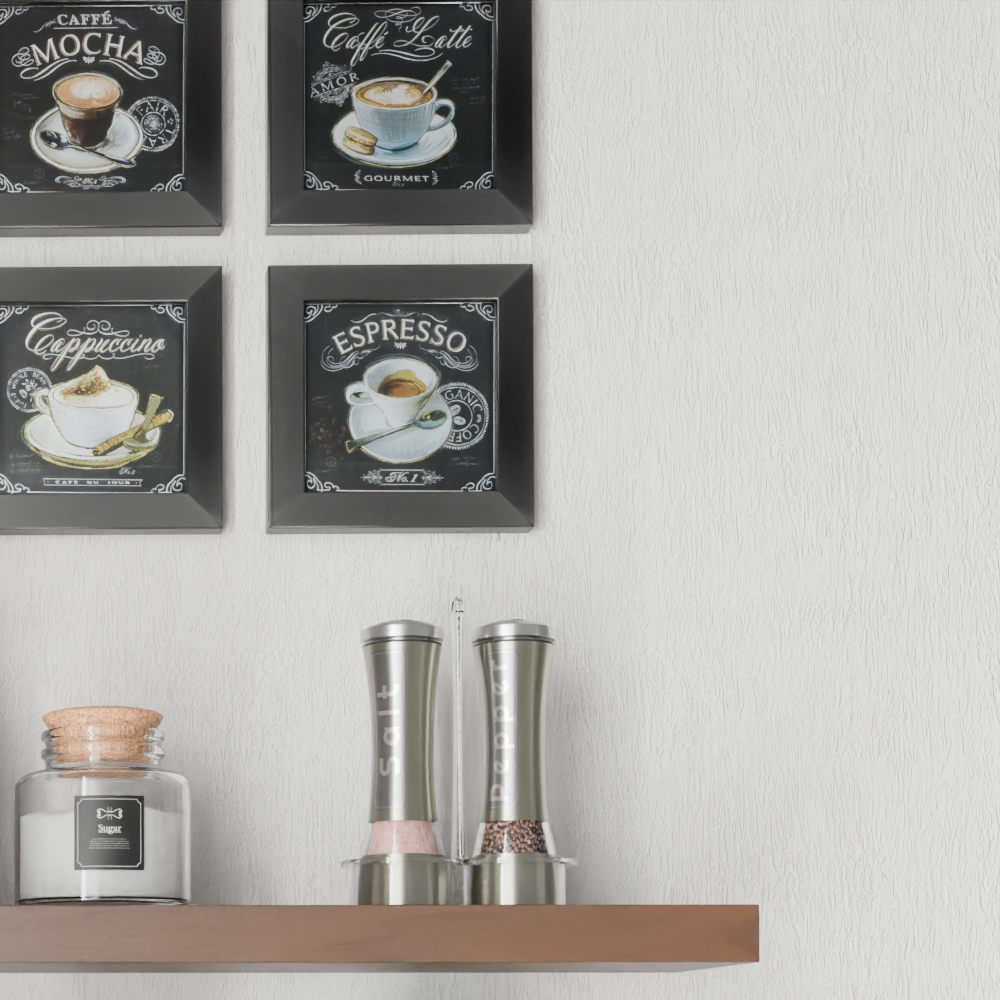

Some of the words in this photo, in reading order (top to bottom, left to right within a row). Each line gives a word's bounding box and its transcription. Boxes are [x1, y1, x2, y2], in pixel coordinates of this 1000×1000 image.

[56, 10, 113, 26] CAFFÉ
[393, 15, 473, 49] Latte
[30, 32, 144, 66] MOCHA
[310, 72, 360, 98] AMOR
[135, 100, 169, 116] FAIR
[143, 129, 176, 148] TRA
[25, 311, 166, 372] Cappuccino
[332, 318, 467, 355] ESPRESSO
[444, 389, 483, 413] GANIC
[448, 424, 480, 443] COFF
[377, 683, 400, 777] Salt
[490, 659, 515, 802] Pepper
[98, 823, 122, 834] Sugar
